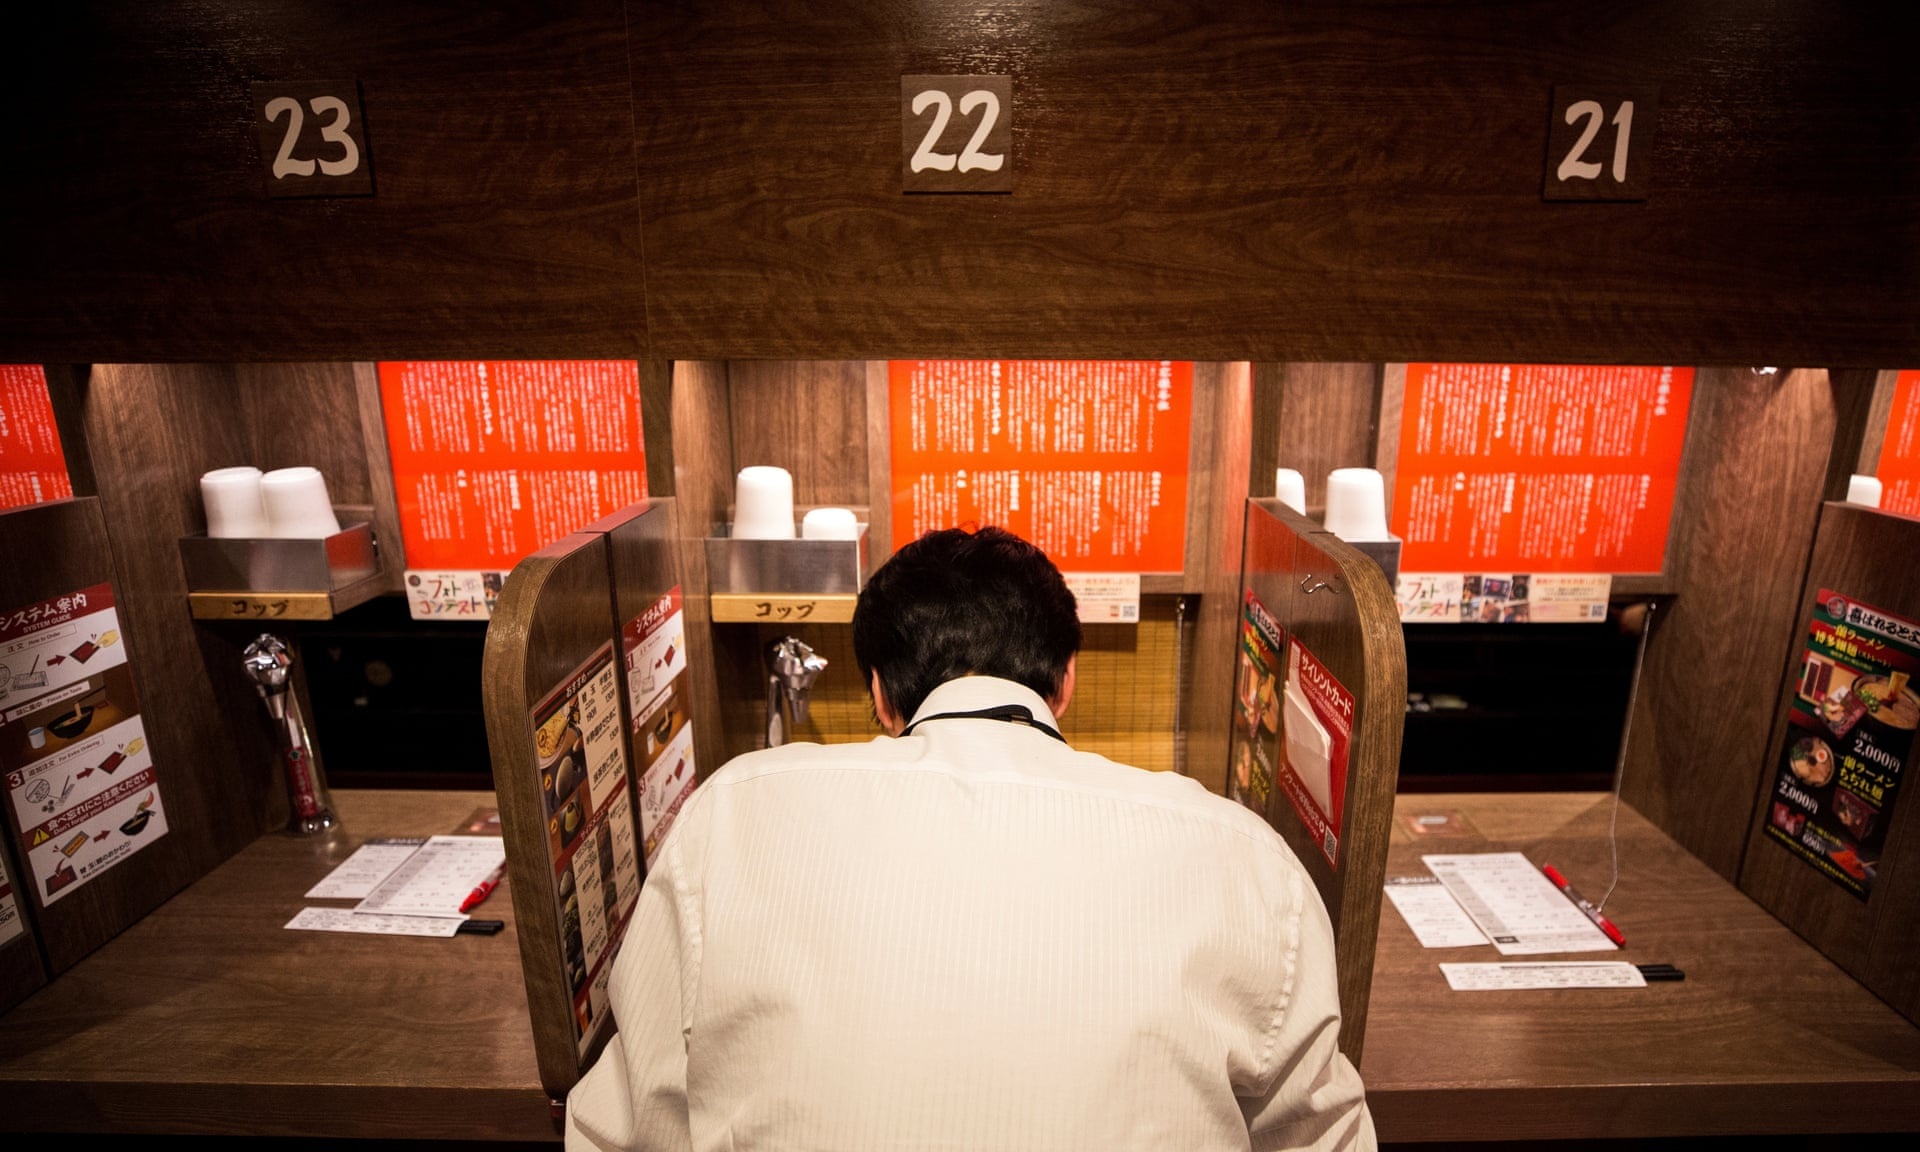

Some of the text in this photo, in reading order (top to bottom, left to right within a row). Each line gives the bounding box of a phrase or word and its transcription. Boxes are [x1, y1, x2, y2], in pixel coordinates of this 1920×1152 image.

[265, 96, 359, 179] 23
[911, 90, 1004, 173] 22
[1557, 100, 1634, 183] 21
[0, 593, 87, 632] システム案内
[23, 613, 72, 633] SYSTEM GUIDE
[232, 599, 289, 617] コップ
[420, 597, 482, 615] コンテスト
[756, 602, 816, 619] コップ
[1301, 653, 1352, 717] サイレントカード
[1853, 737, 1901, 774] 2,000円
[10, 774, 23, 788] 3
